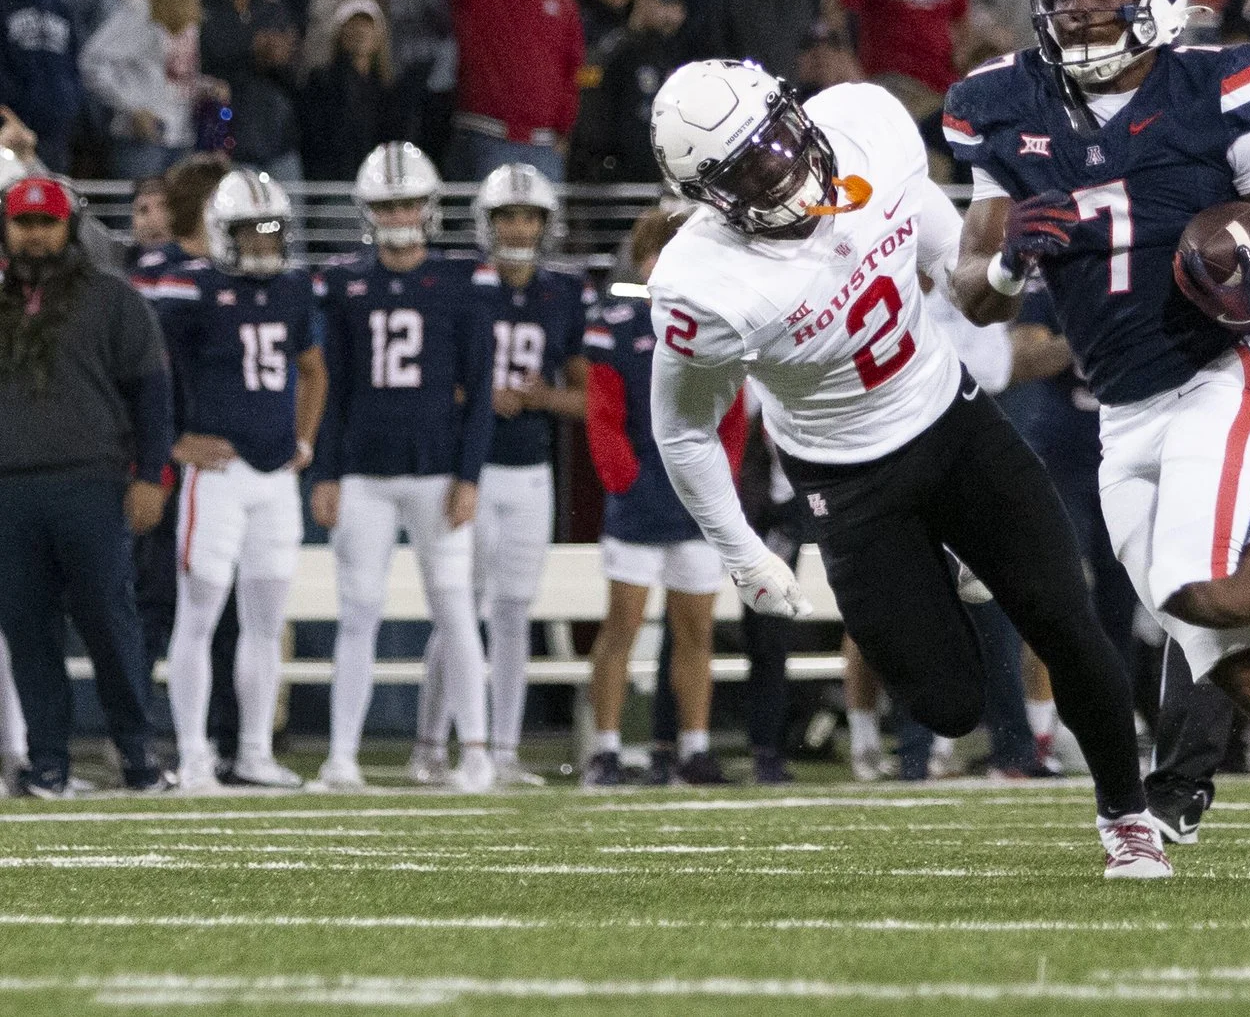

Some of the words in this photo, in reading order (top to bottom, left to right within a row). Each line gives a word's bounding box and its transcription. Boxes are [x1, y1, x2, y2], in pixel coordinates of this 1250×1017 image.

[724, 116, 755, 147] HOUSTON
[1071, 179, 1133, 294] 7
[791, 217, 914, 346] HOUSTON
[240, 322, 288, 391] 15
[369, 309, 424, 388] 12
[494, 320, 546, 389] 19
[665, 308, 698, 357] 2
[845, 275, 917, 391] 2
